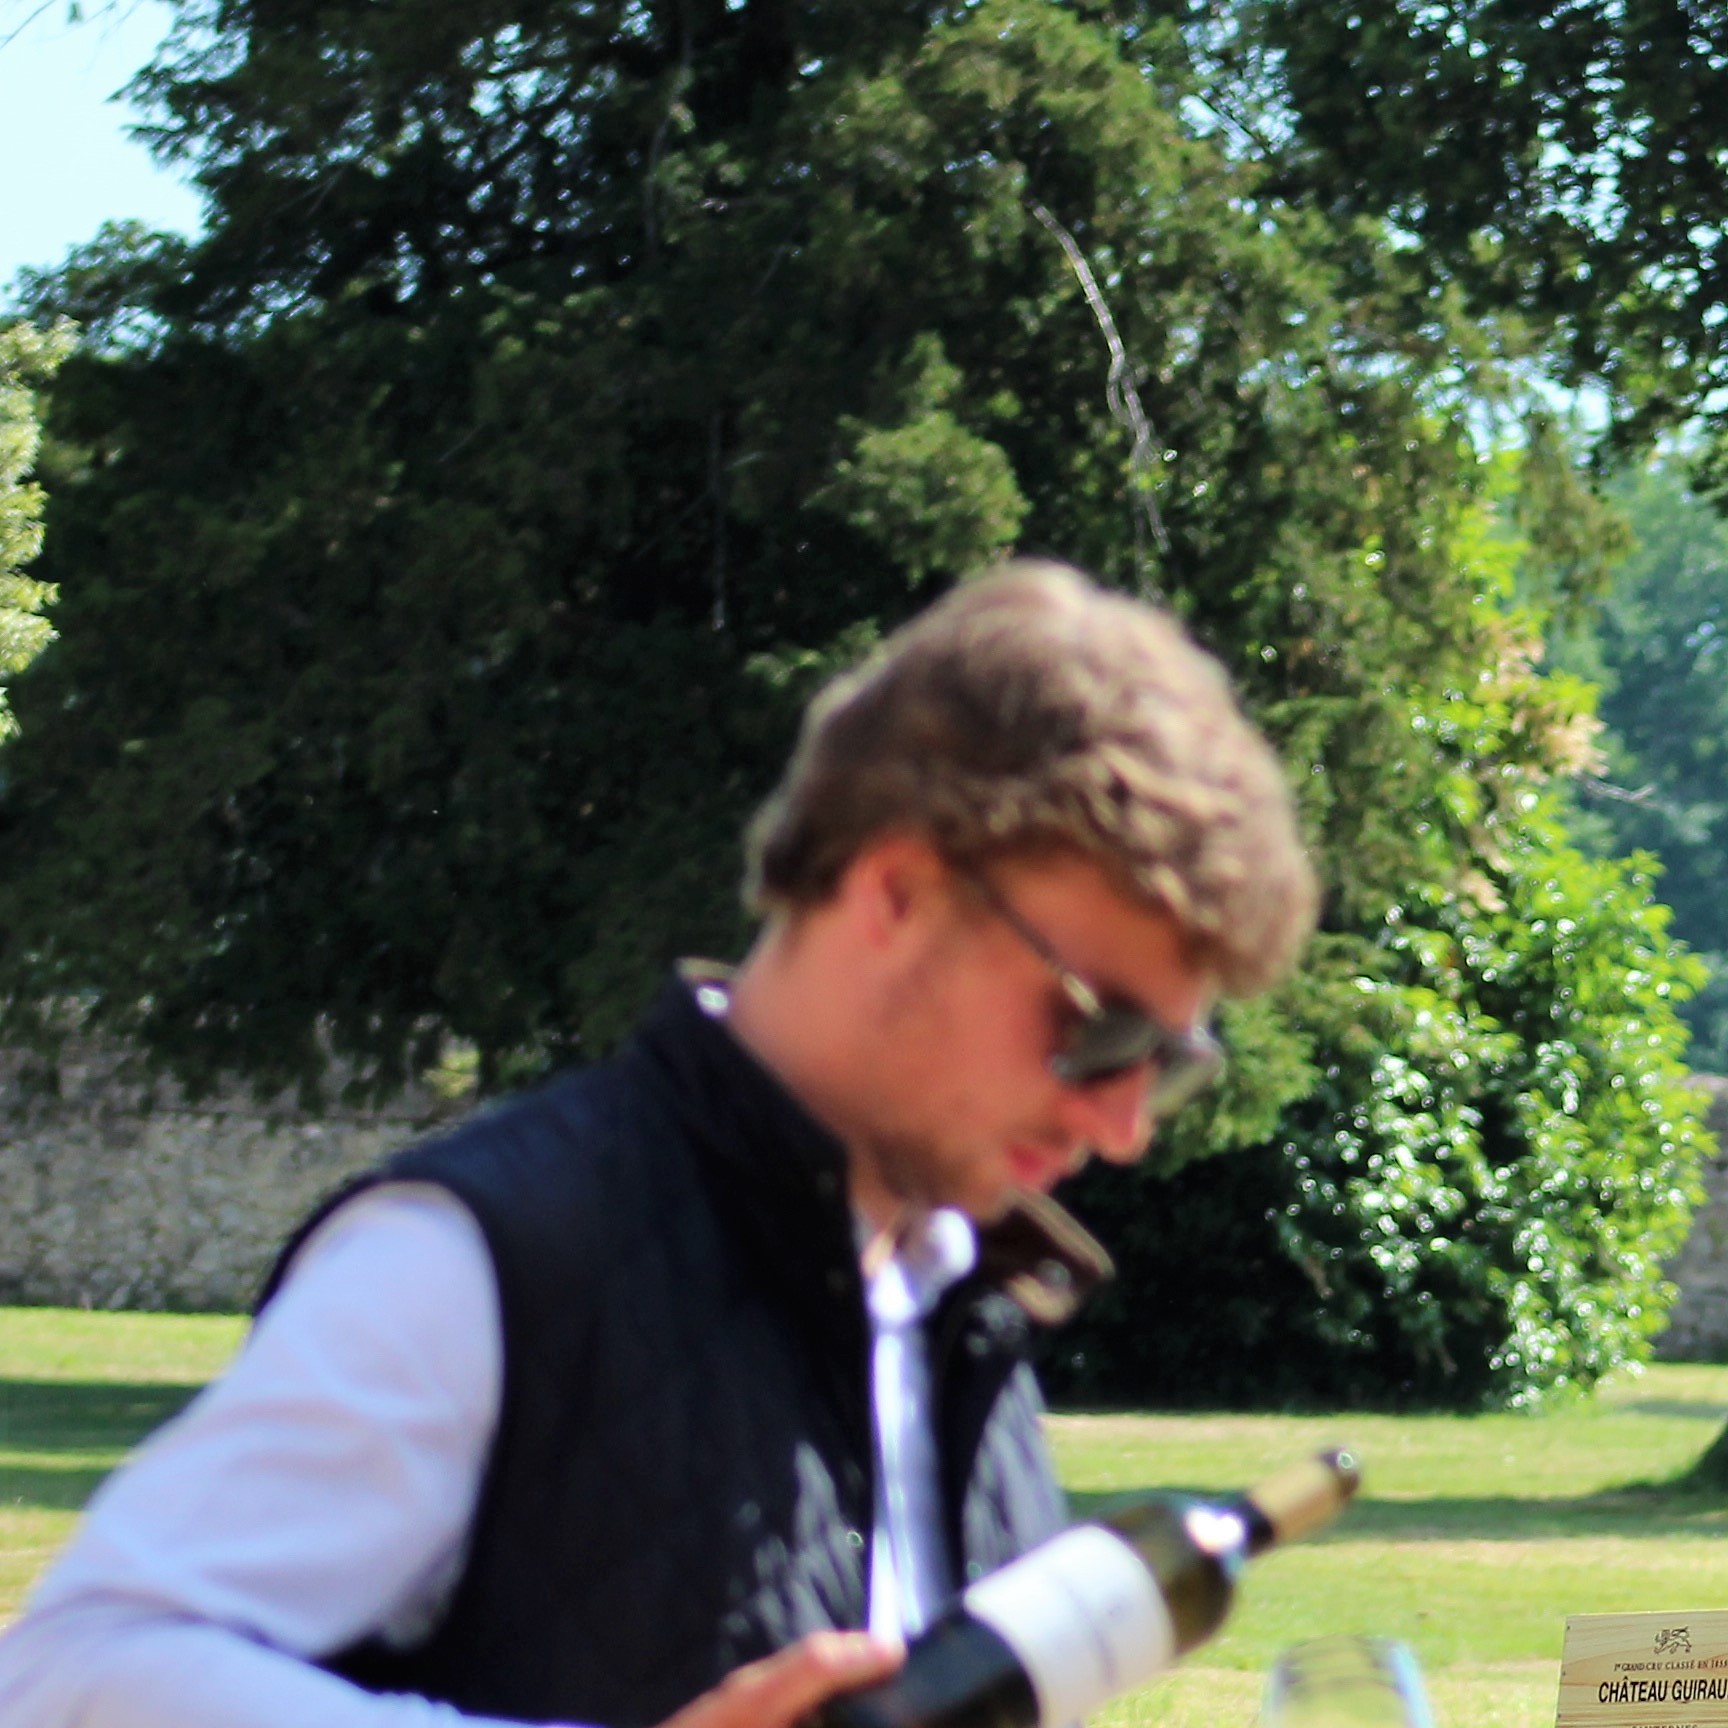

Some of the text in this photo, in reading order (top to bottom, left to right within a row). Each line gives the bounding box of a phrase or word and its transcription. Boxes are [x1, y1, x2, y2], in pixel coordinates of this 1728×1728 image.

[1646, 1661, 1662, 1670] CRU
[1697, 1660, 1709, 1669] EN
[1599, 1676, 1668, 1703] CHÂTEAU
